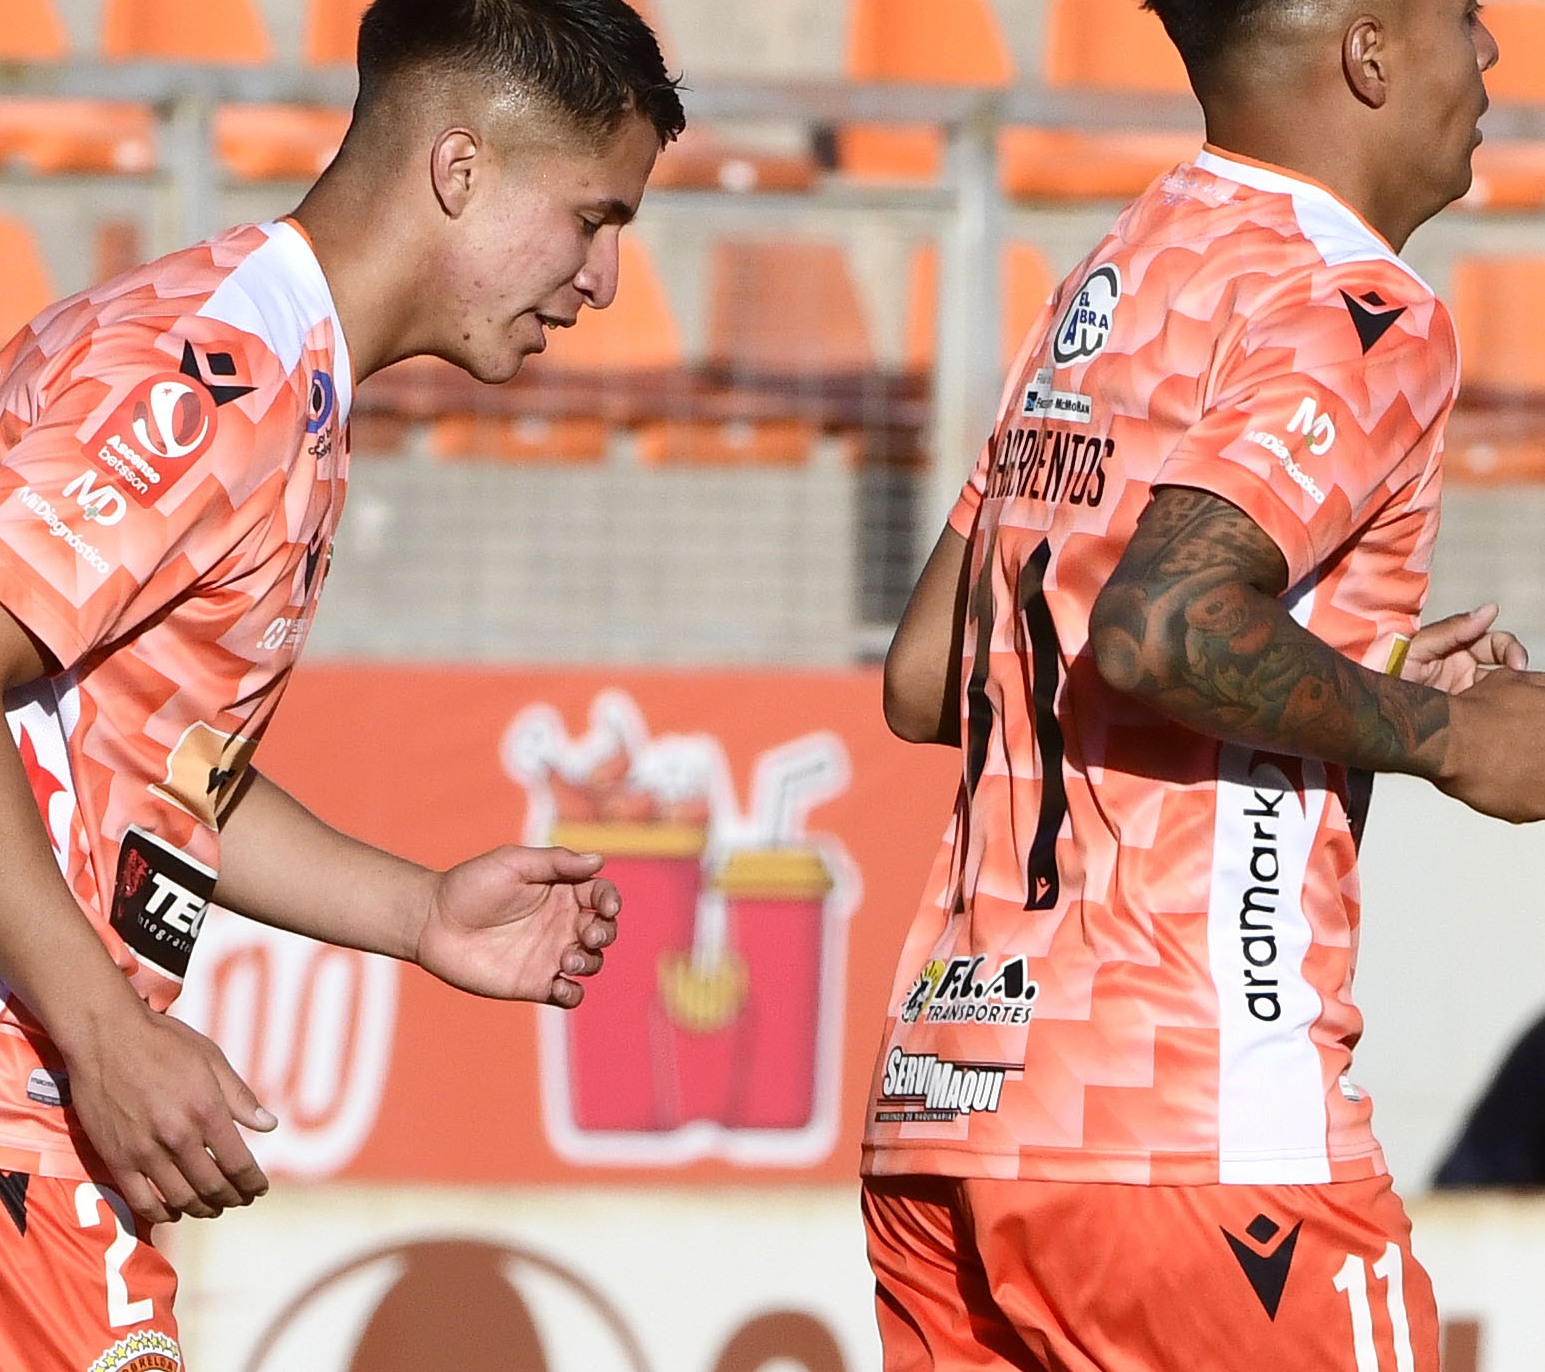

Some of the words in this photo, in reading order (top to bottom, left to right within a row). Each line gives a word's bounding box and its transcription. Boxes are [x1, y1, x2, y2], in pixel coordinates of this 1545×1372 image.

[1063, 308, 1109, 345] ABRA
[1286, 397, 1336, 456] MD
[98, 445, 149, 495] betsson
[106, 434, 161, 484] Ascenso
[62, 469, 127, 526] MD
[18, 486, 110, 574] MiDiagnóstico
[1239, 787, 1286, 1023] aramark
[925, 1003, 1032, 1024] TRANSPORTES
[74, 1182, 154, 1328] 2
